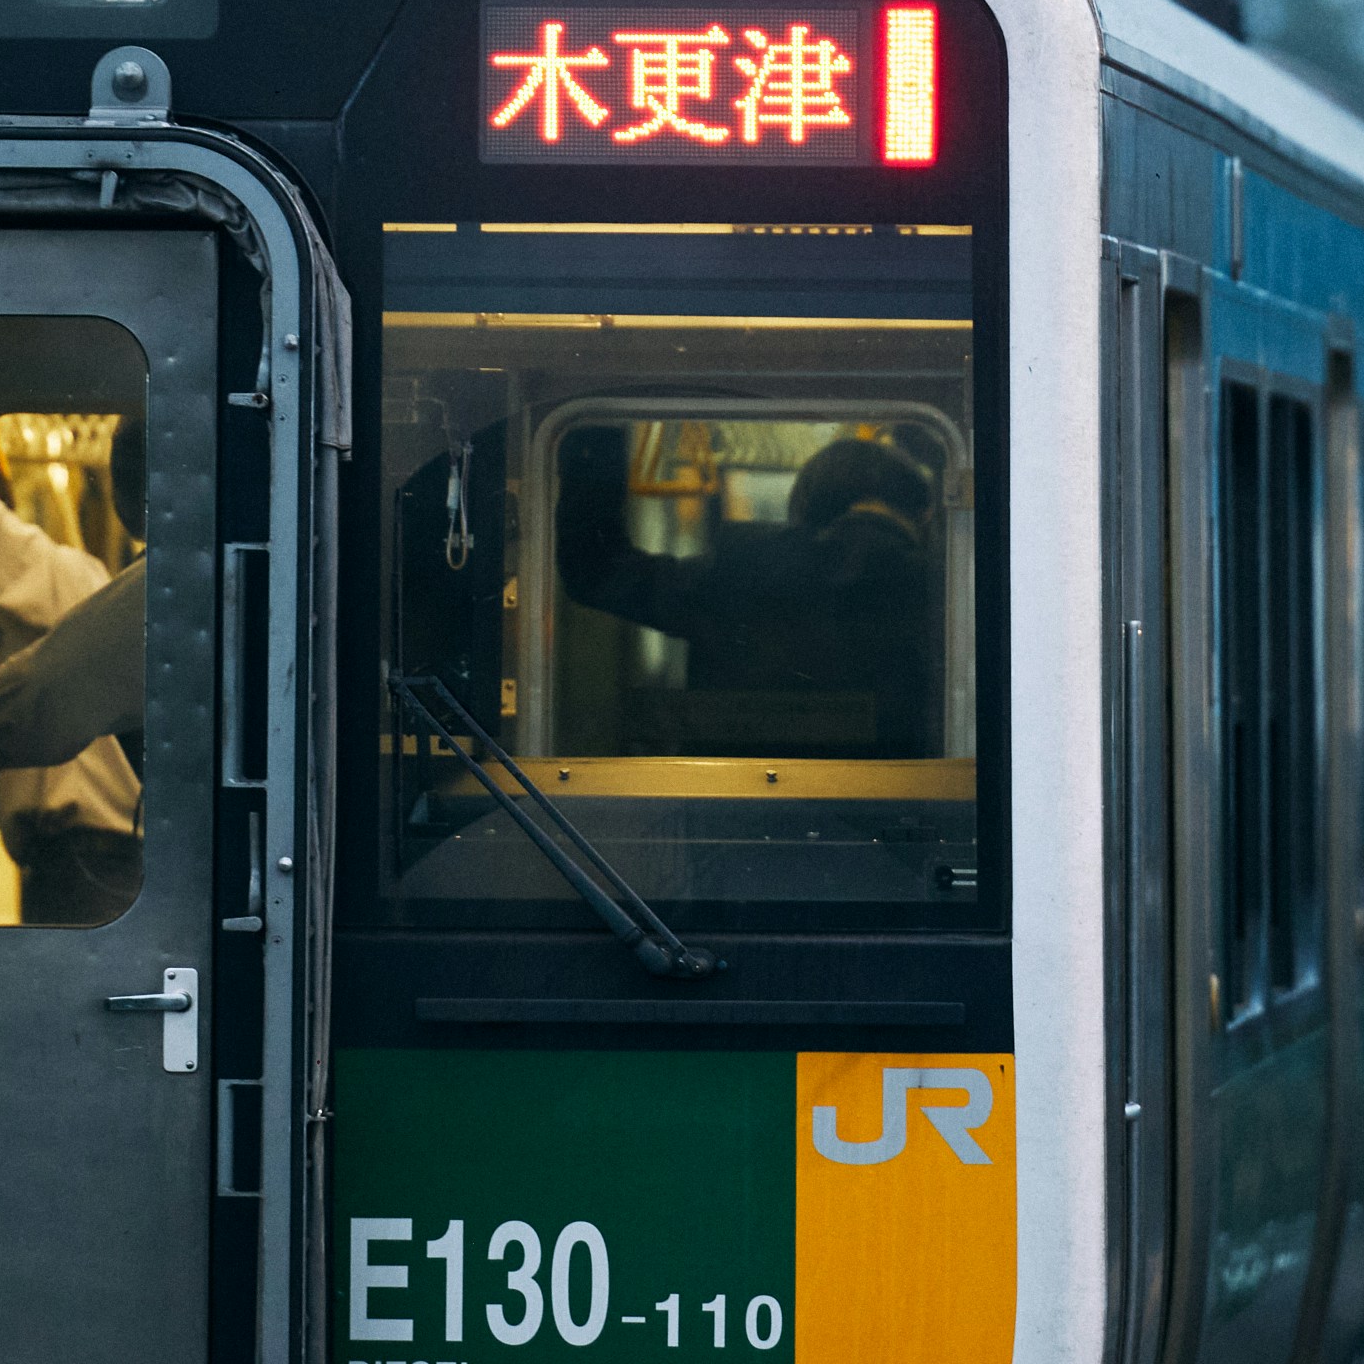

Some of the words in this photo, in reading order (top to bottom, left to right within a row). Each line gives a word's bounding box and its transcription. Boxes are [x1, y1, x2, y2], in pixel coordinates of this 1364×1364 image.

[491, 21, 852, 143] 木更津
[811, 1067, 995, 1166] JR
